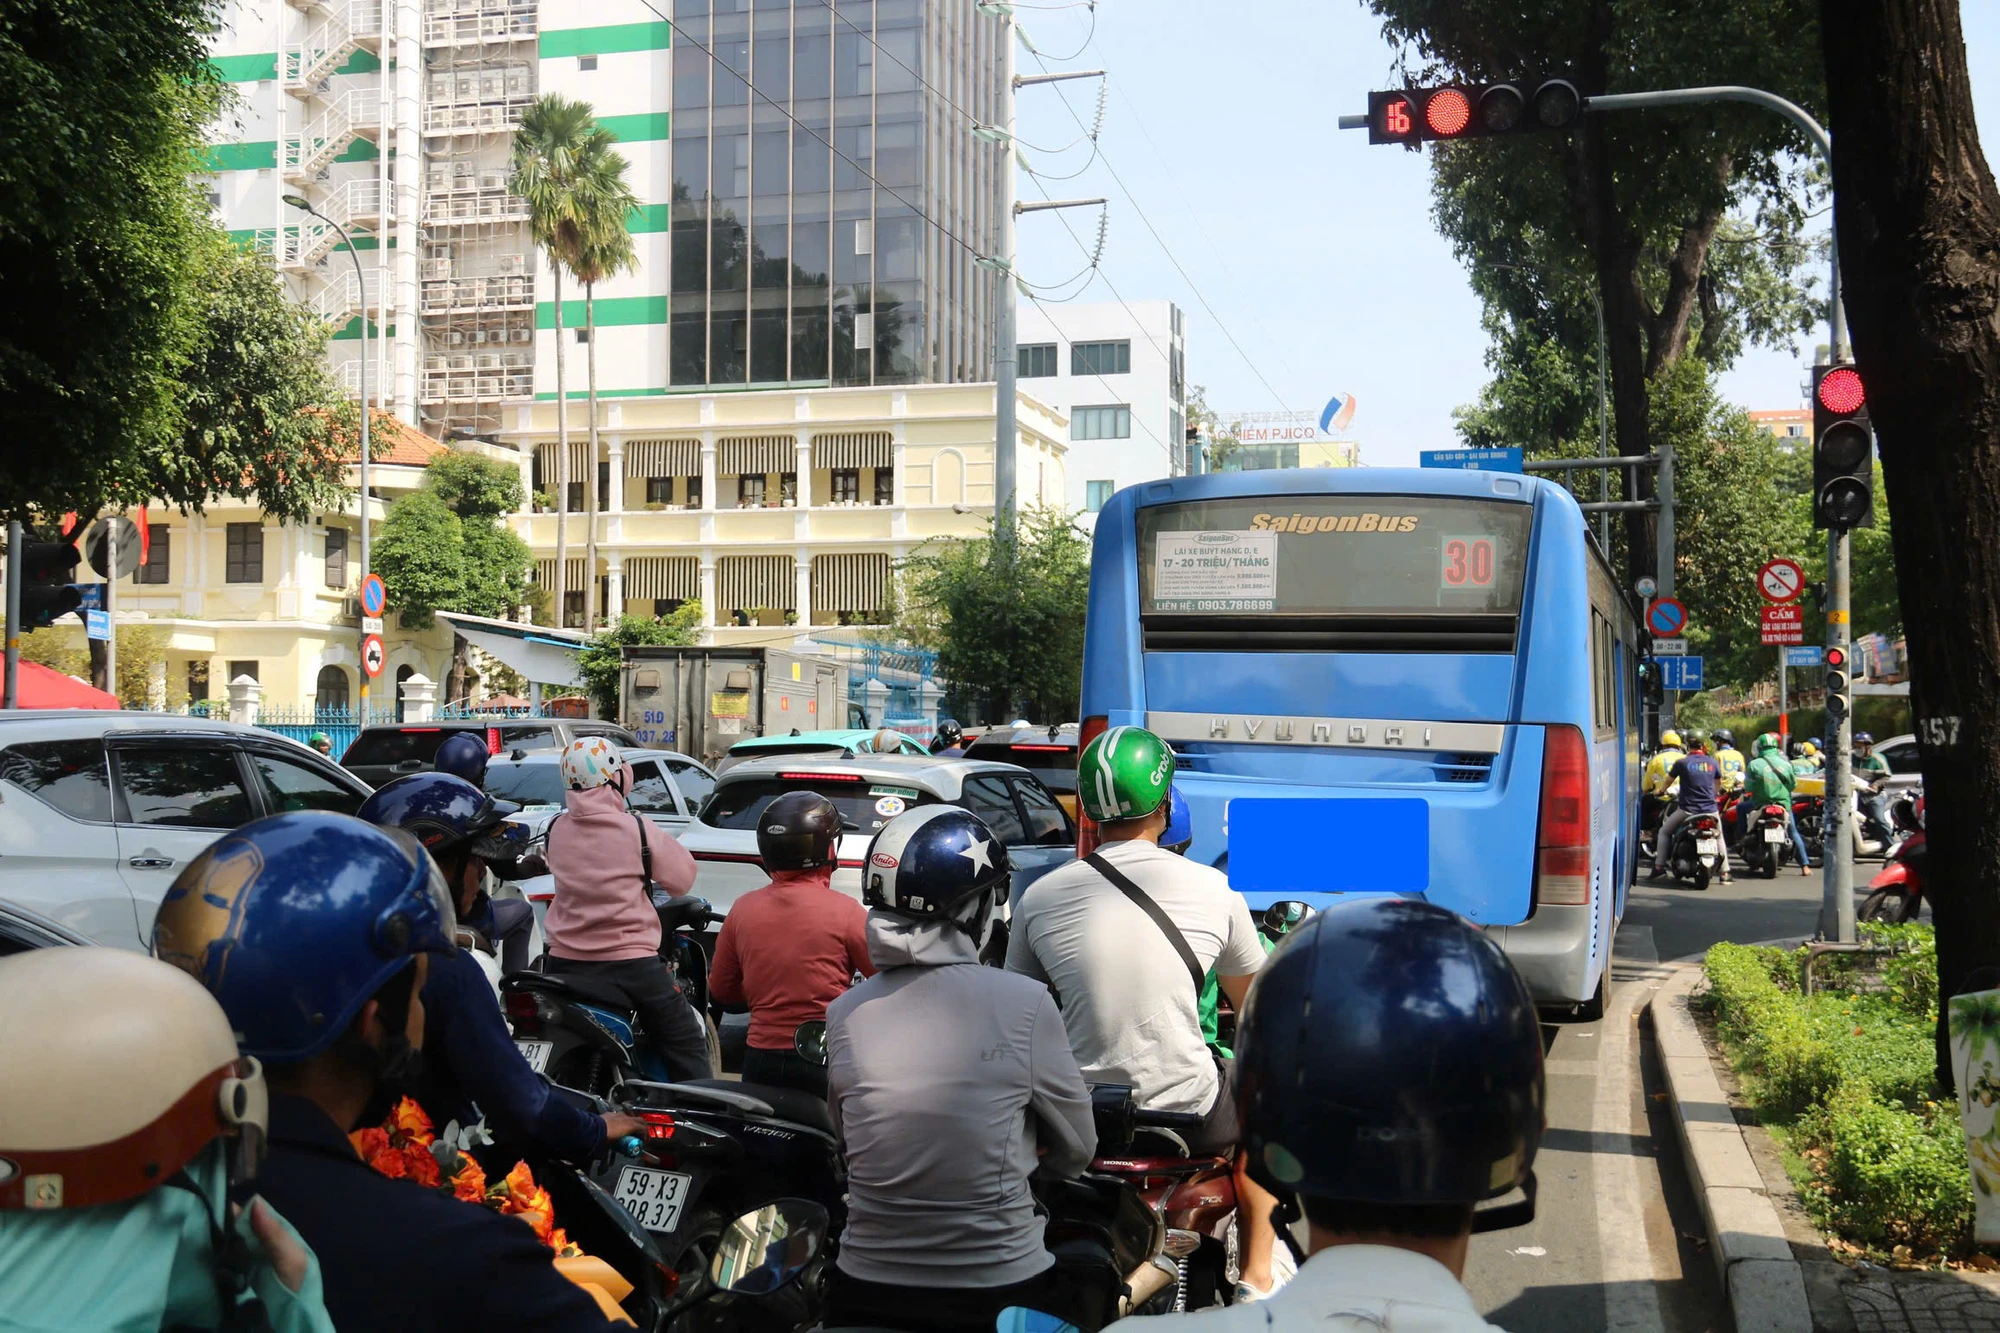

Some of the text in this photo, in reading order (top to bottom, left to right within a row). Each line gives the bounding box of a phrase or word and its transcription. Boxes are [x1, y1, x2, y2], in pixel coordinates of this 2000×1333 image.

[1386, 101, 1412, 133] 16
[1272, 427, 1315, 439] PJICO
[1250, 512, 1419, 535] SaigonBus
[1188, 547, 1198, 555] XE
[1162, 558, 1173, 568] 17
[1181, 558, 1194, 568] 20
[1444, 539, 1494, 585] 30
[1156, 600, 1178, 611] LIÊN
[1197, 600, 1274, 611] 0903.786699
[1769, 607, 1795, 620] CẤM
[1834, 613, 1840, 622] 2
[644, 710, 665, 724] 51D
[635, 730, 676, 743] 037.28
[1209, 717, 1433, 746] HYUNDAI
[1919, 715, 1963, 746] 157
[1150, 753, 1170, 786] Grab
[627, 1171, 679, 1201] 59-X3
